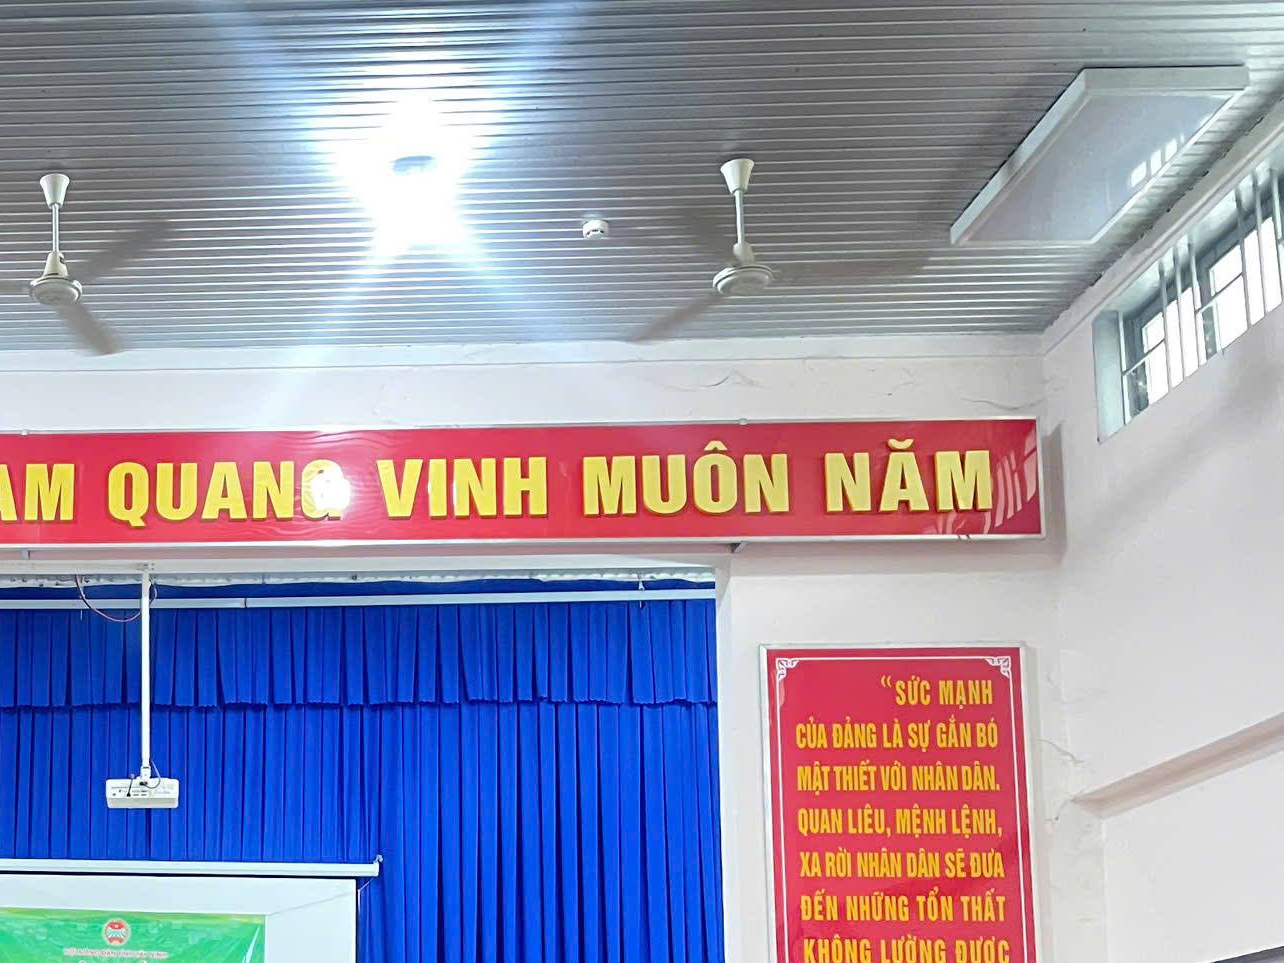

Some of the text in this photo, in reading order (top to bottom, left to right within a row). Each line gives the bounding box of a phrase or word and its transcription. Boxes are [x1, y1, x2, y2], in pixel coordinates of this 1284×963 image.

[107, 461, 352, 528] QUANG
[378, 456, 549, 520] VINH
[582, 441, 791, 519] MUÔN
[825, 436, 996, 514] NĂM
[939, 680, 992, 709] MẠNH
[796, 715, 997, 752] CỦA ĐẢNG LÀ SỰ GẮN BÓ
[797, 760, 999, 795] MẬT THIẾT VỚI NHÂN DÂN.
[798, 804, 1002, 838] QUAN LIÊU, MỆNH LỆNH,
[800, 847, 1004, 877] XA RỜI NHÂN DÂN SẼ ĐƯA
[801, 887, 1005, 921] ĐẾN NHỮNG TỔN THẤT
